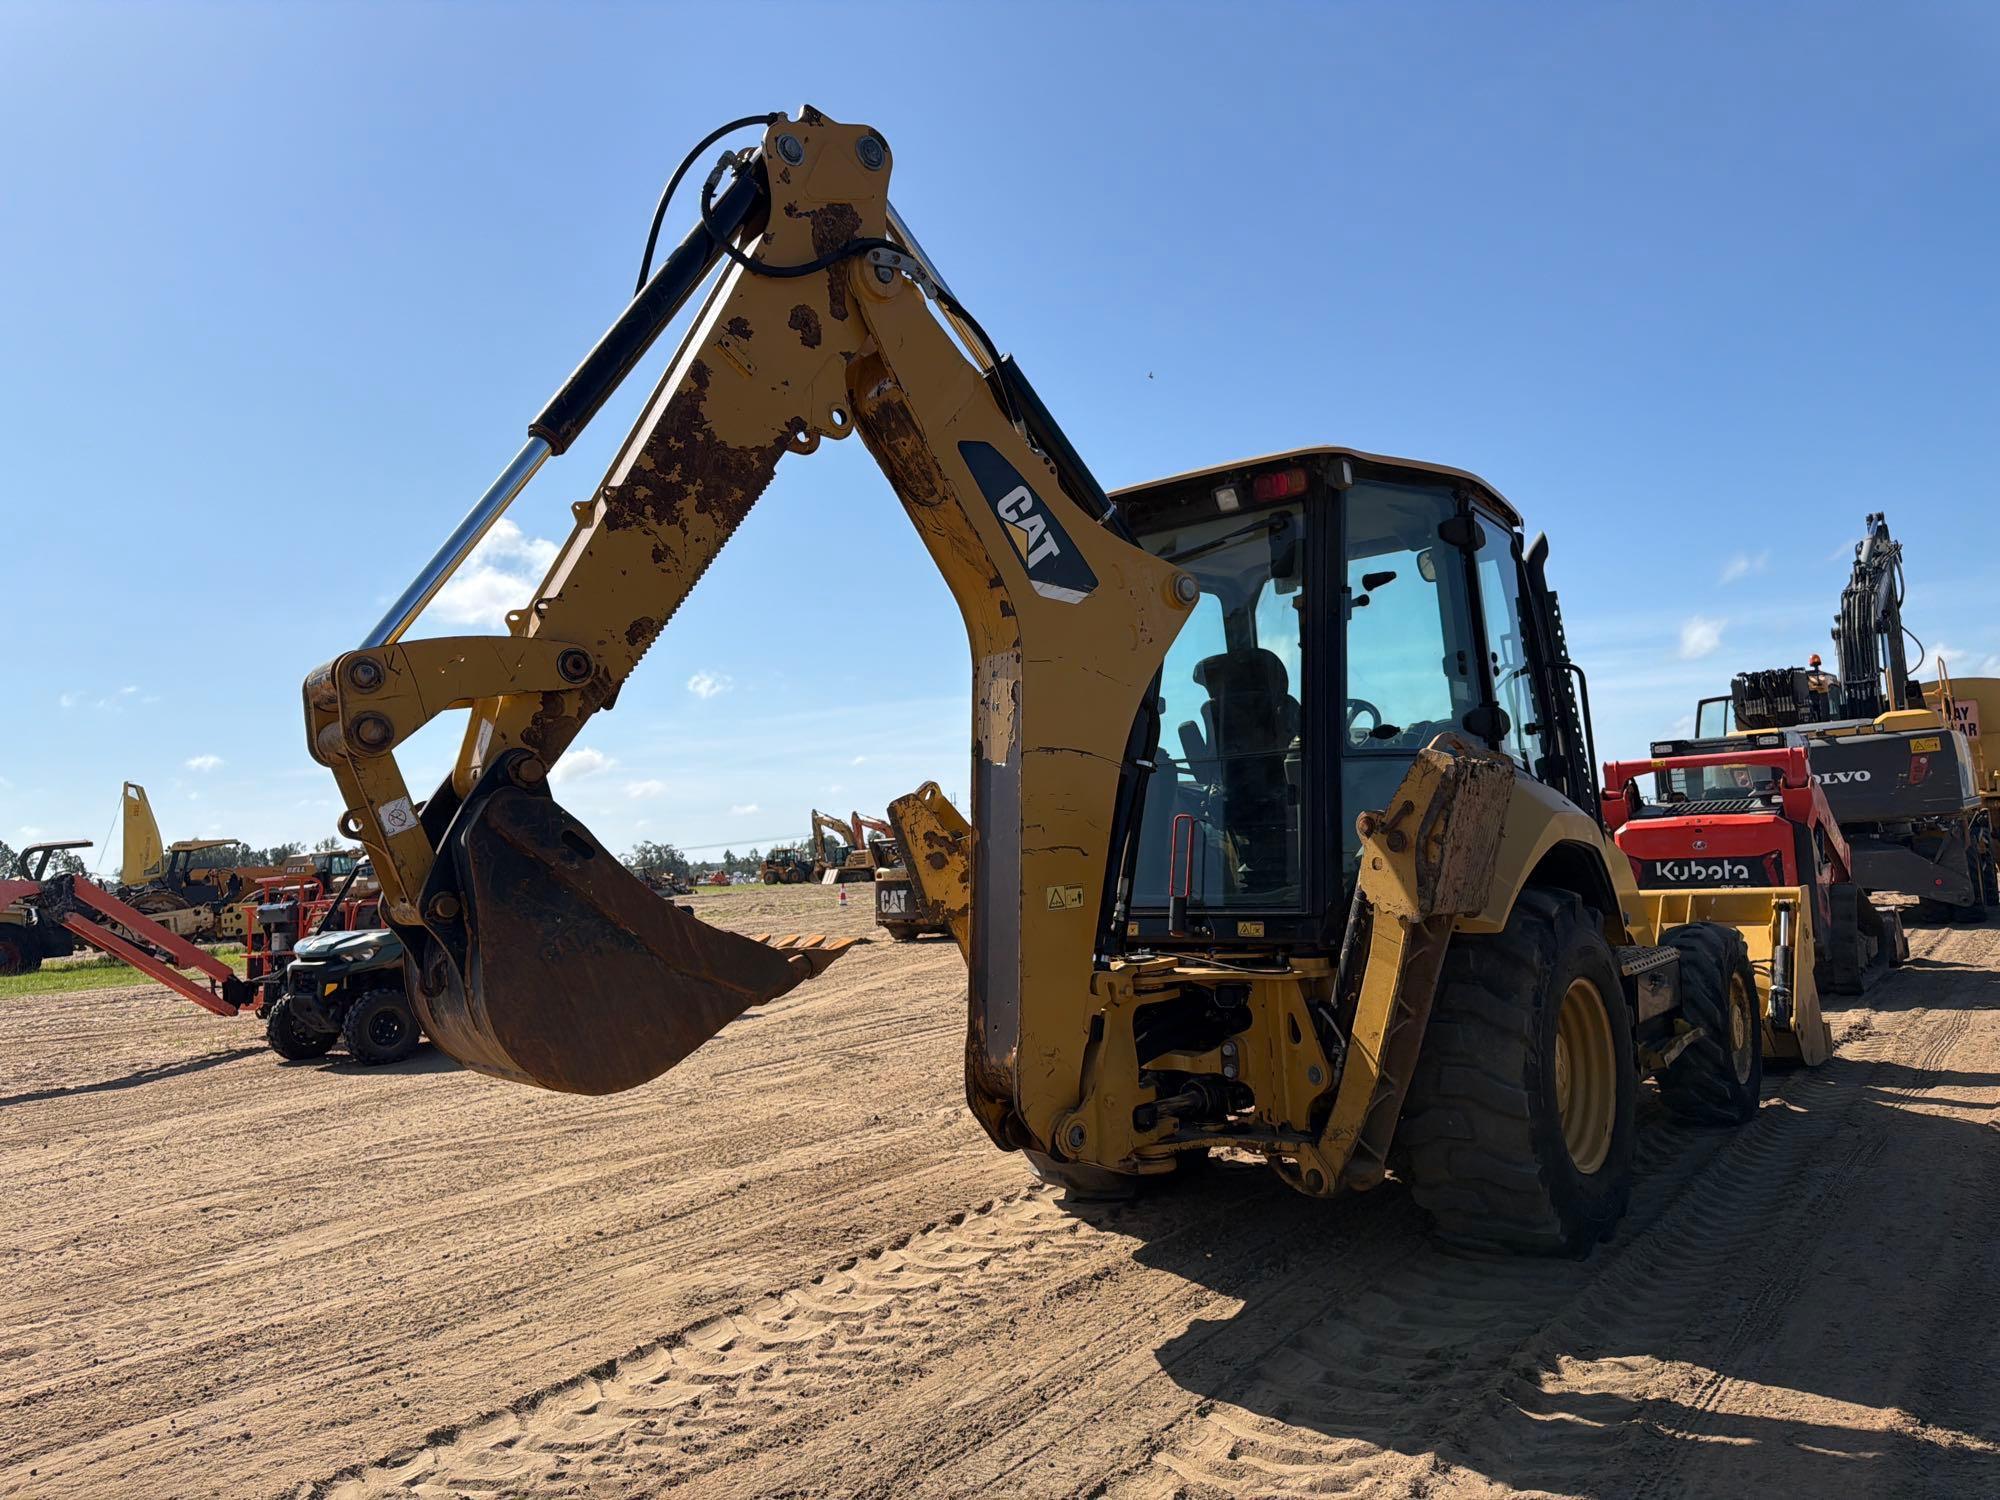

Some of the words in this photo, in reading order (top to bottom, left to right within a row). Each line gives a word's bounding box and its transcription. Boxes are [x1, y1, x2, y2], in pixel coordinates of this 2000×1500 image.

[997, 485, 1060, 569] CAT
[1656, 860, 1749, 881] Kubota
[880, 890, 908, 913] CAT
